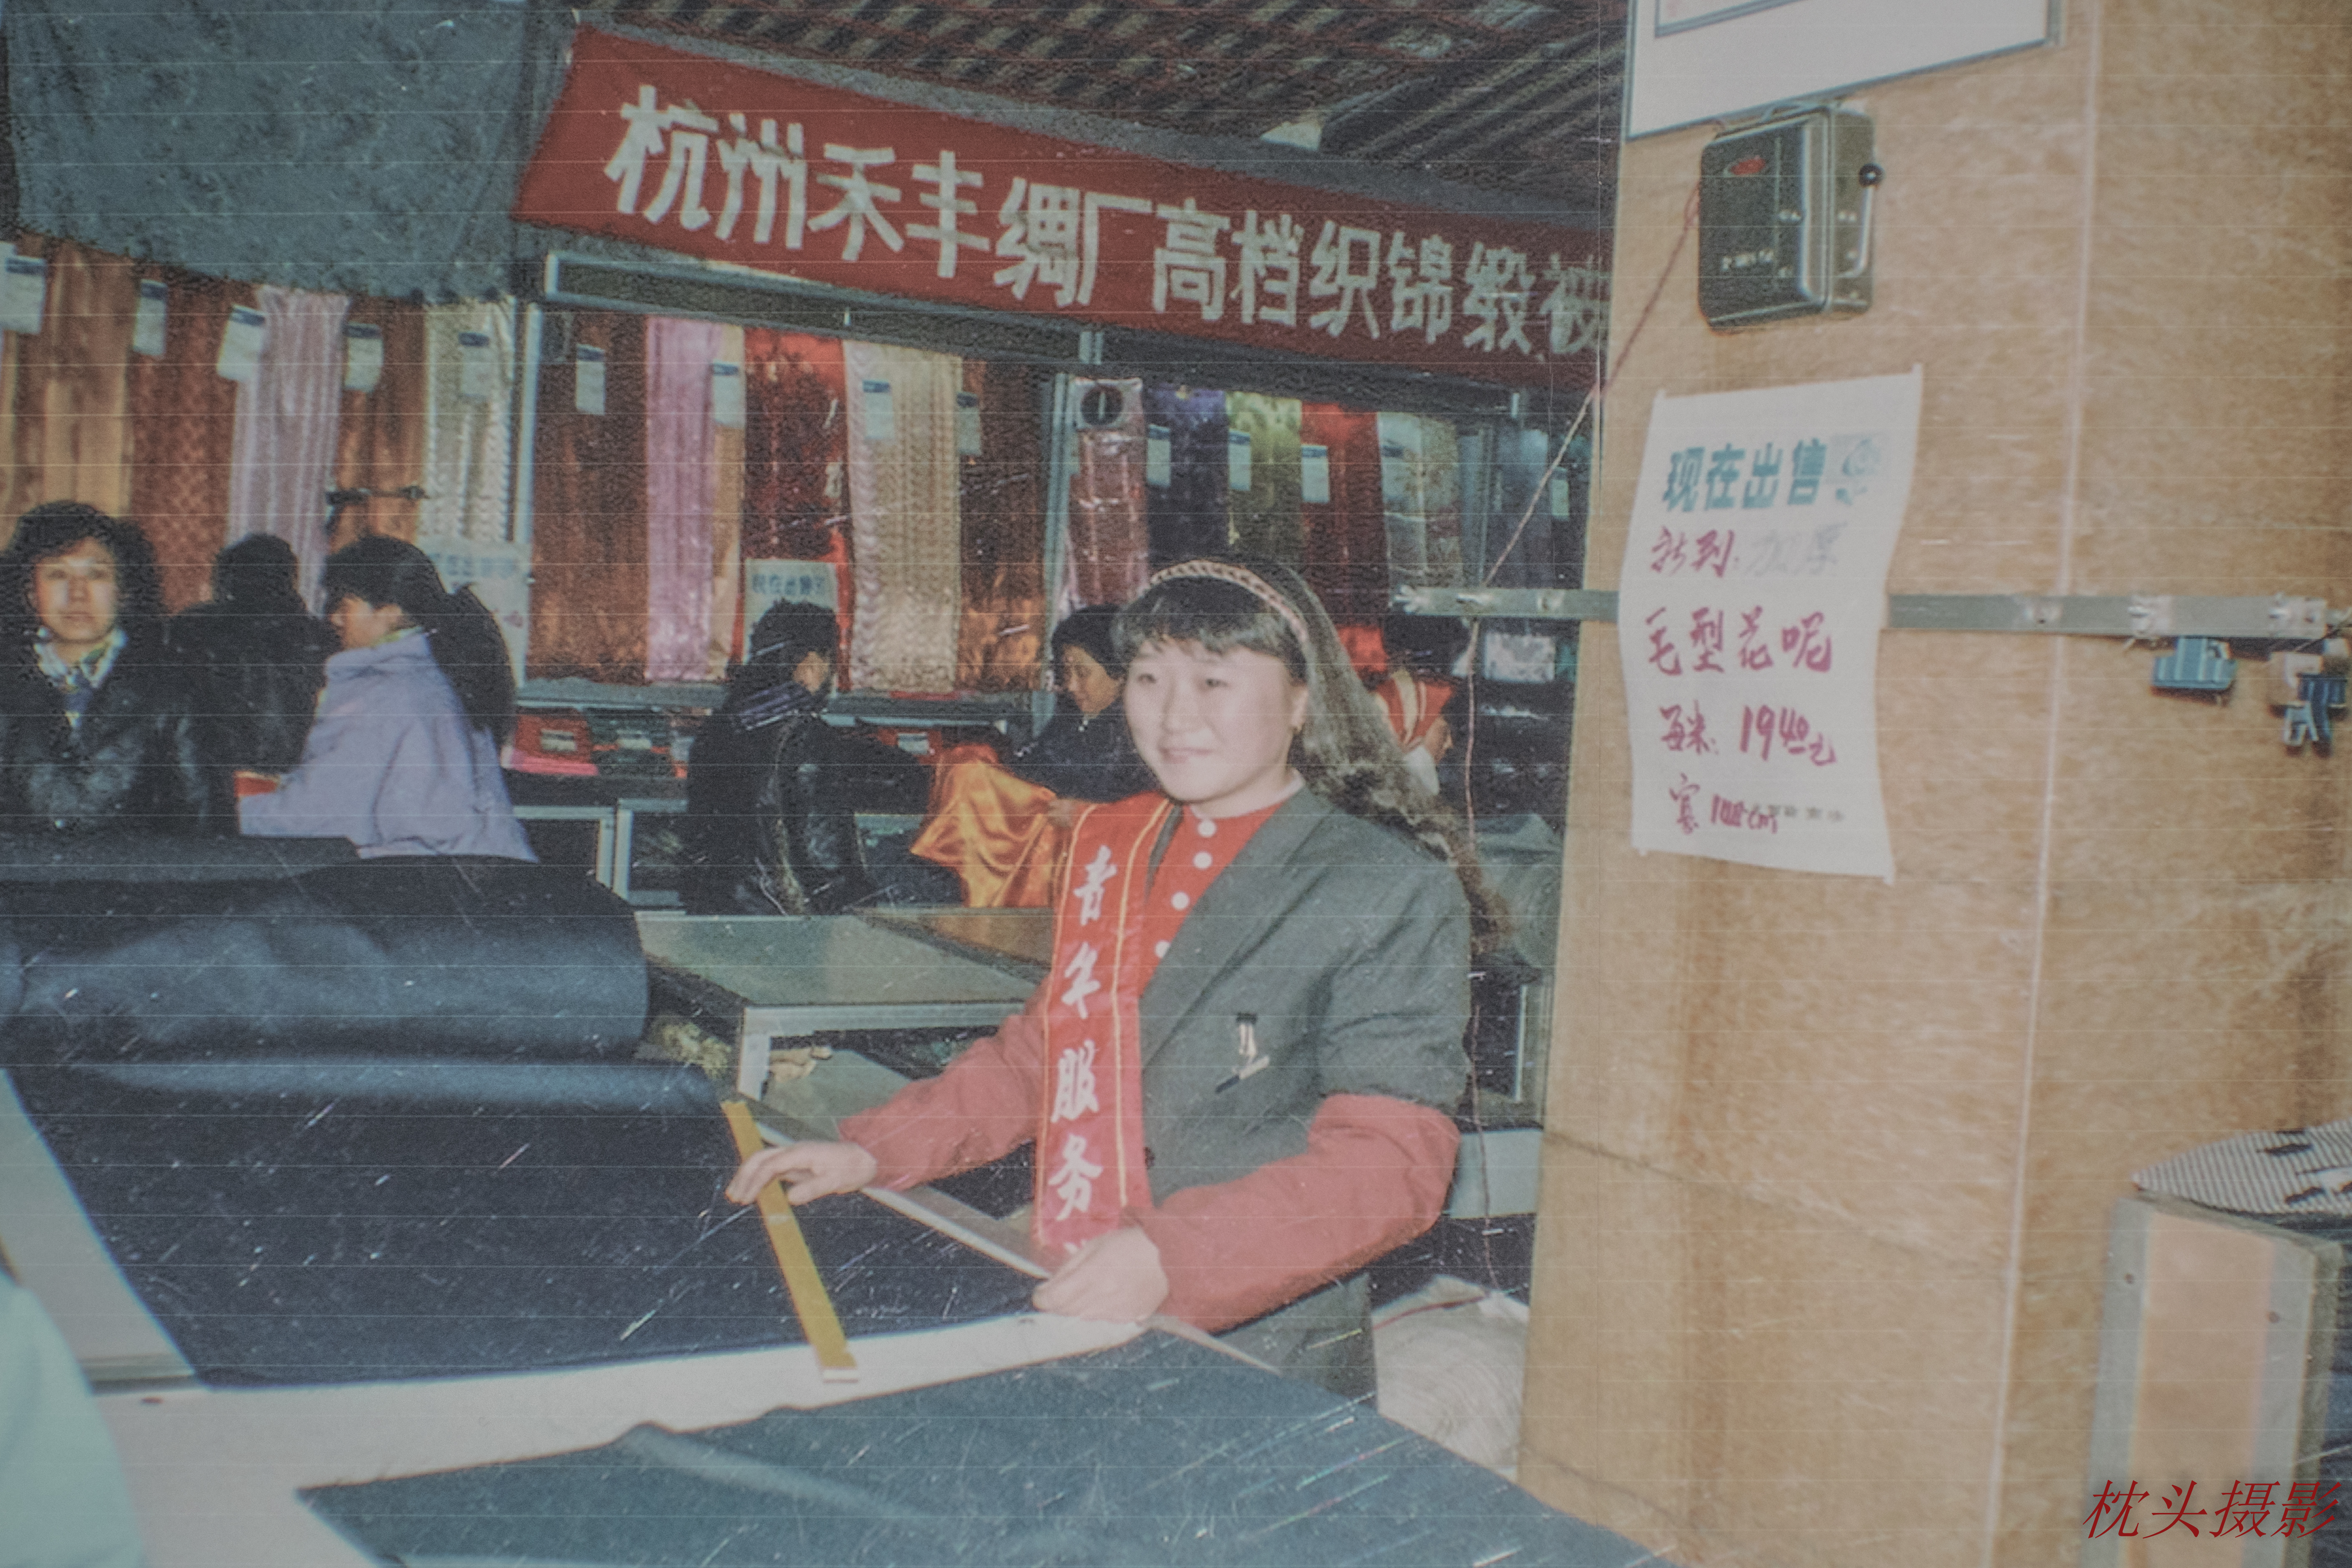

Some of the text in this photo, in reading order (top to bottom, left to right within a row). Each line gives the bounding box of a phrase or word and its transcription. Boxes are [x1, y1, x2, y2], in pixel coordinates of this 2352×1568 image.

[1662, 438, 1828, 512] 现在出售
[1645, 605, 1833, 676] 毛型花呢
[1049, 845, 1117, 1254] 青年服务
